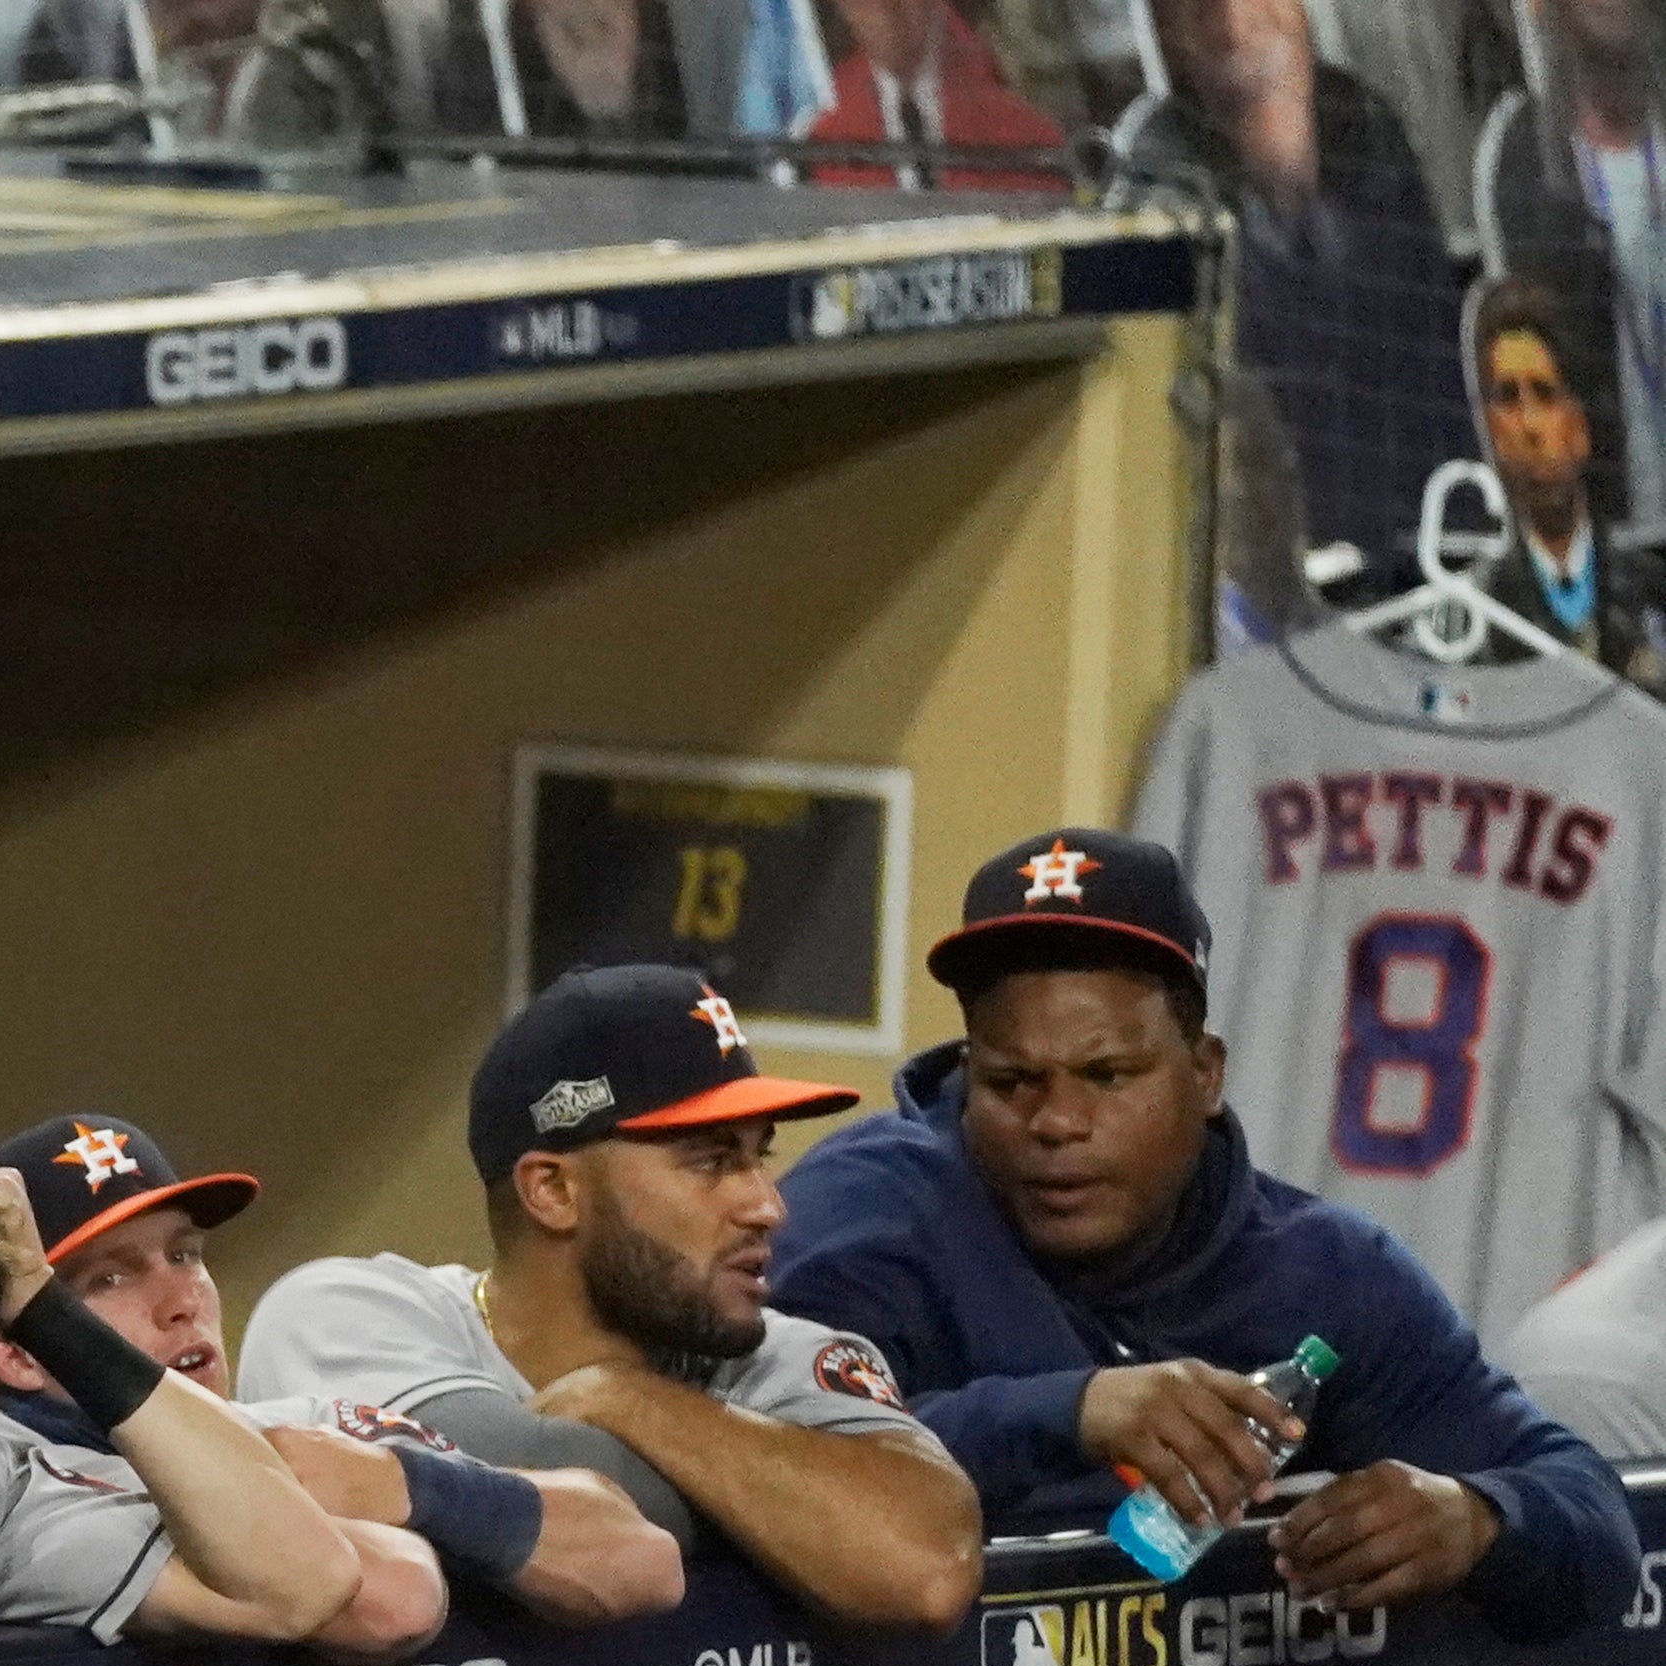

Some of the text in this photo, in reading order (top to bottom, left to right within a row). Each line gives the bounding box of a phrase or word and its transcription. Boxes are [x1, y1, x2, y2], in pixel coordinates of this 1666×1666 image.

[145, 317, 348, 405] GEICO
[672, 847, 749, 938] 13
[1256, 768, 1617, 908] PETTIS
[1329, 907, 1496, 1181] 8
